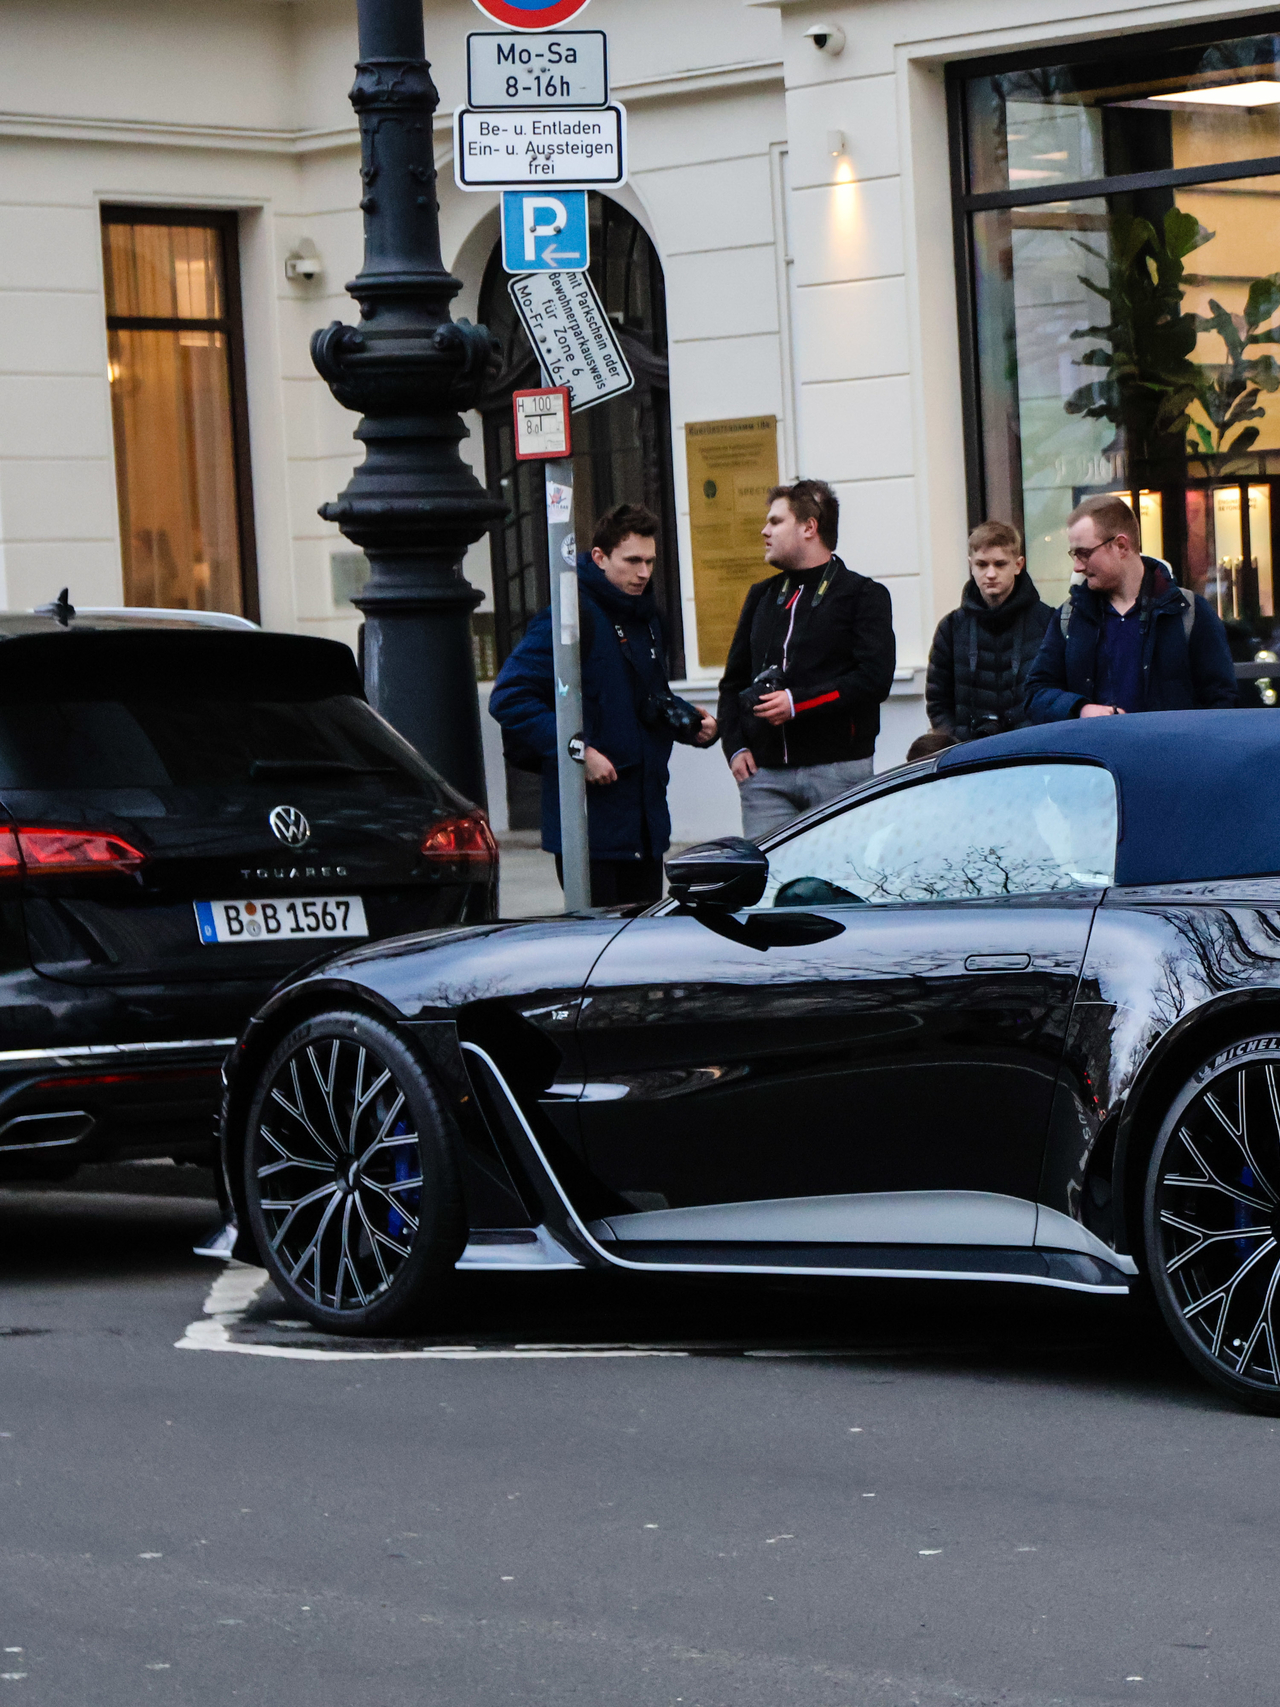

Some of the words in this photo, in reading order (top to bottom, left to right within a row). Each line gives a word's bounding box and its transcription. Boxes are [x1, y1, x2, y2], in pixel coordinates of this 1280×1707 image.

[496, 42, 577, 65] Mo-Sa
[505, 75, 570, 98] 8-16h
[480, 122, 508, 136] Be-
[514, 123, 527, 136] u.
[532, 120, 601, 136] Entladen
[468, 141, 500, 156] Ein-
[505, 143, 519, 156] u.
[525, 139, 613, 158] Aussteigen
[528, 159, 555, 175] frei
[522, 196, 568, 261] P
[517, 284, 544, 330] Mo-Fr
[541, 299, 558, 320] für
[553, 325, 575, 363] Zone
[571, 367, 585, 377] 6
[548, 272, 607, 390] Bewohnerparkausweis
[565, 272, 583, 290] mit
[575, 291, 607, 351] Parkschein
[602, 353, 621, 378] oder
[517, 399, 525, 413] H
[532, 396, 552, 412] 100
[224, 904, 244, 936] B
[261, 903, 282, 934] B
[286, 900, 350, 934] 1567
